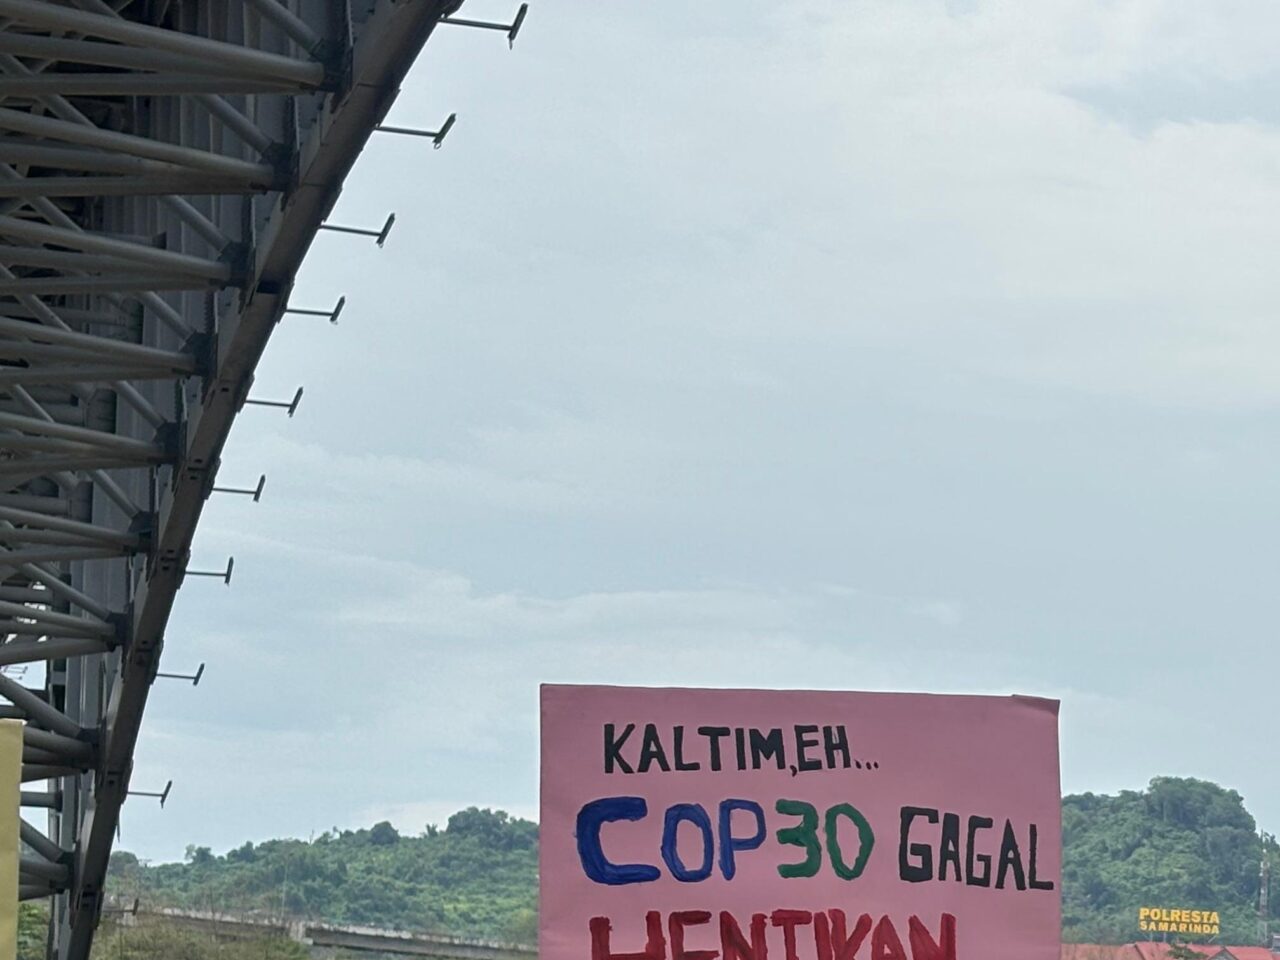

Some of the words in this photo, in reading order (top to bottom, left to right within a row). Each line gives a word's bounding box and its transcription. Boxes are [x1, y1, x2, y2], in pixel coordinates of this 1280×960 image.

[576, 797, 875, 884] COP30
[899, 806, 1054, 891] GAGAL
[1139, 907, 1220, 924] POLRESTA
[1139, 921, 1220, 934] SAMARINDA
